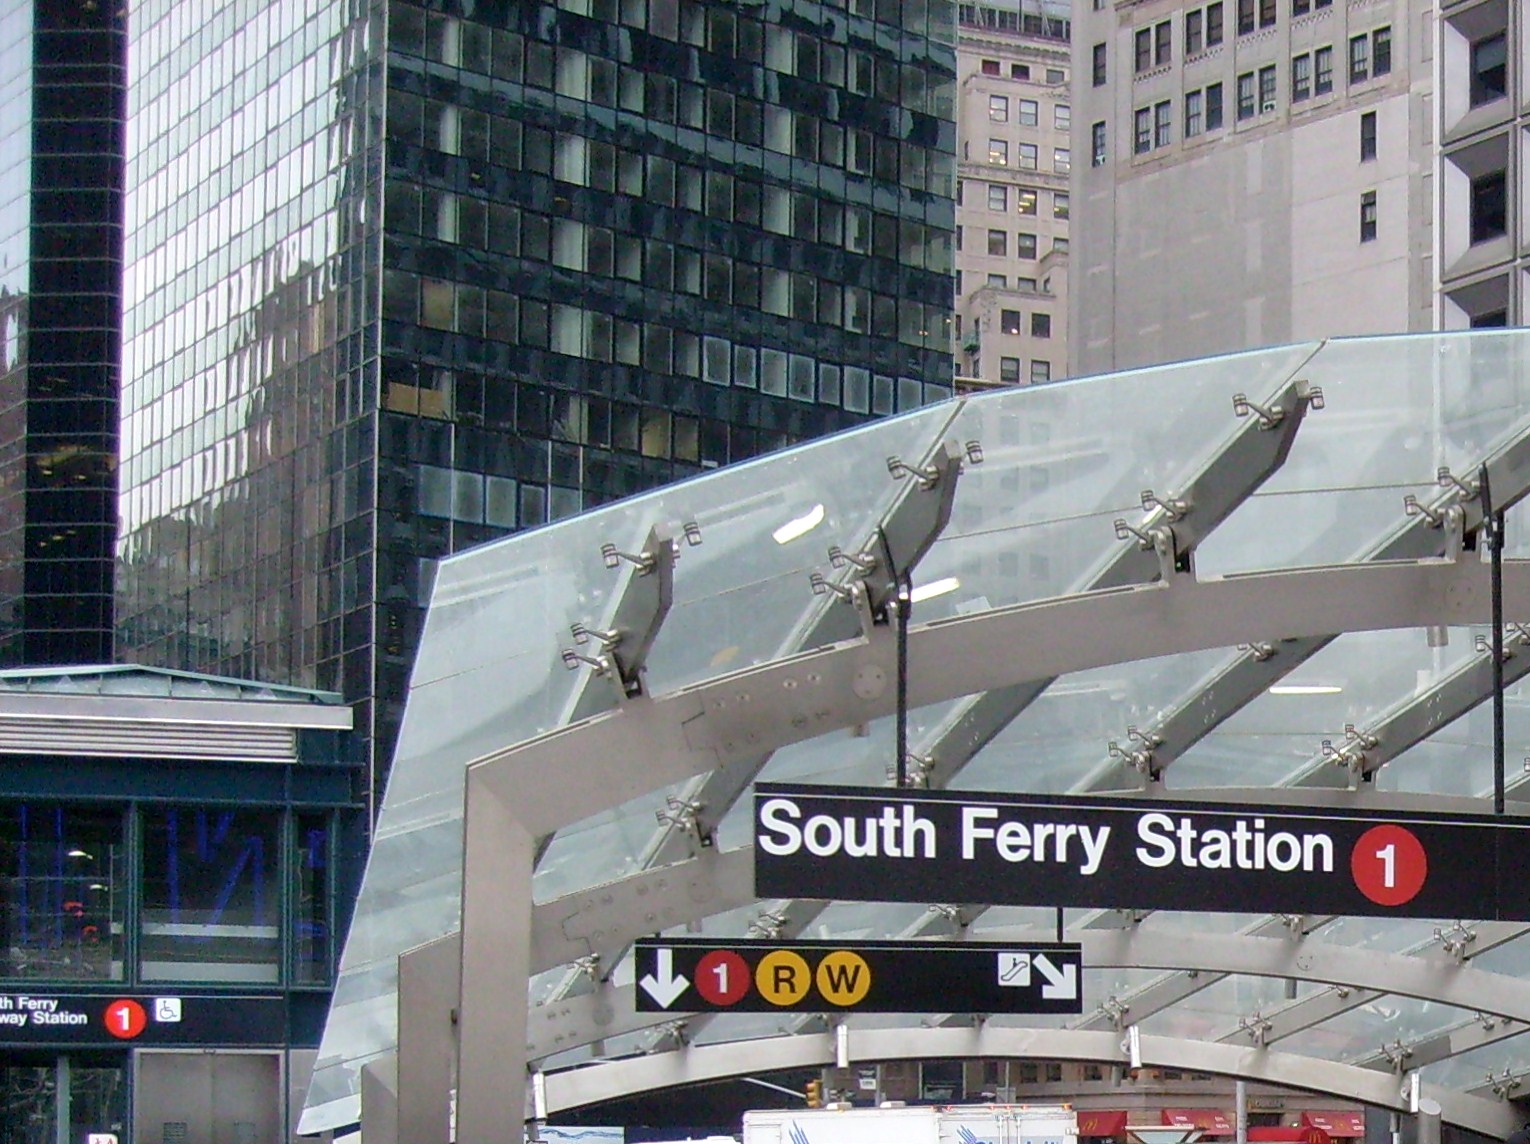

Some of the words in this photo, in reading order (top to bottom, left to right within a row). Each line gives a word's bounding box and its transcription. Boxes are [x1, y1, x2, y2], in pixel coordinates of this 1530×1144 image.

[759, 798, 936, 858] South
[961, 806, 1111, 875] Ferry
[1136, 813, 1334, 872] Station
[1375, 844, 1396, 888] 1
[712, 962, 729, 994] 1
[773, 965, 797, 994] R
[825, 965, 862, 994] W
[18, 996, 59, 1012] Ferry
[33, 1011, 88, 1025] Station
[116, 1007, 130, 1031] 1
